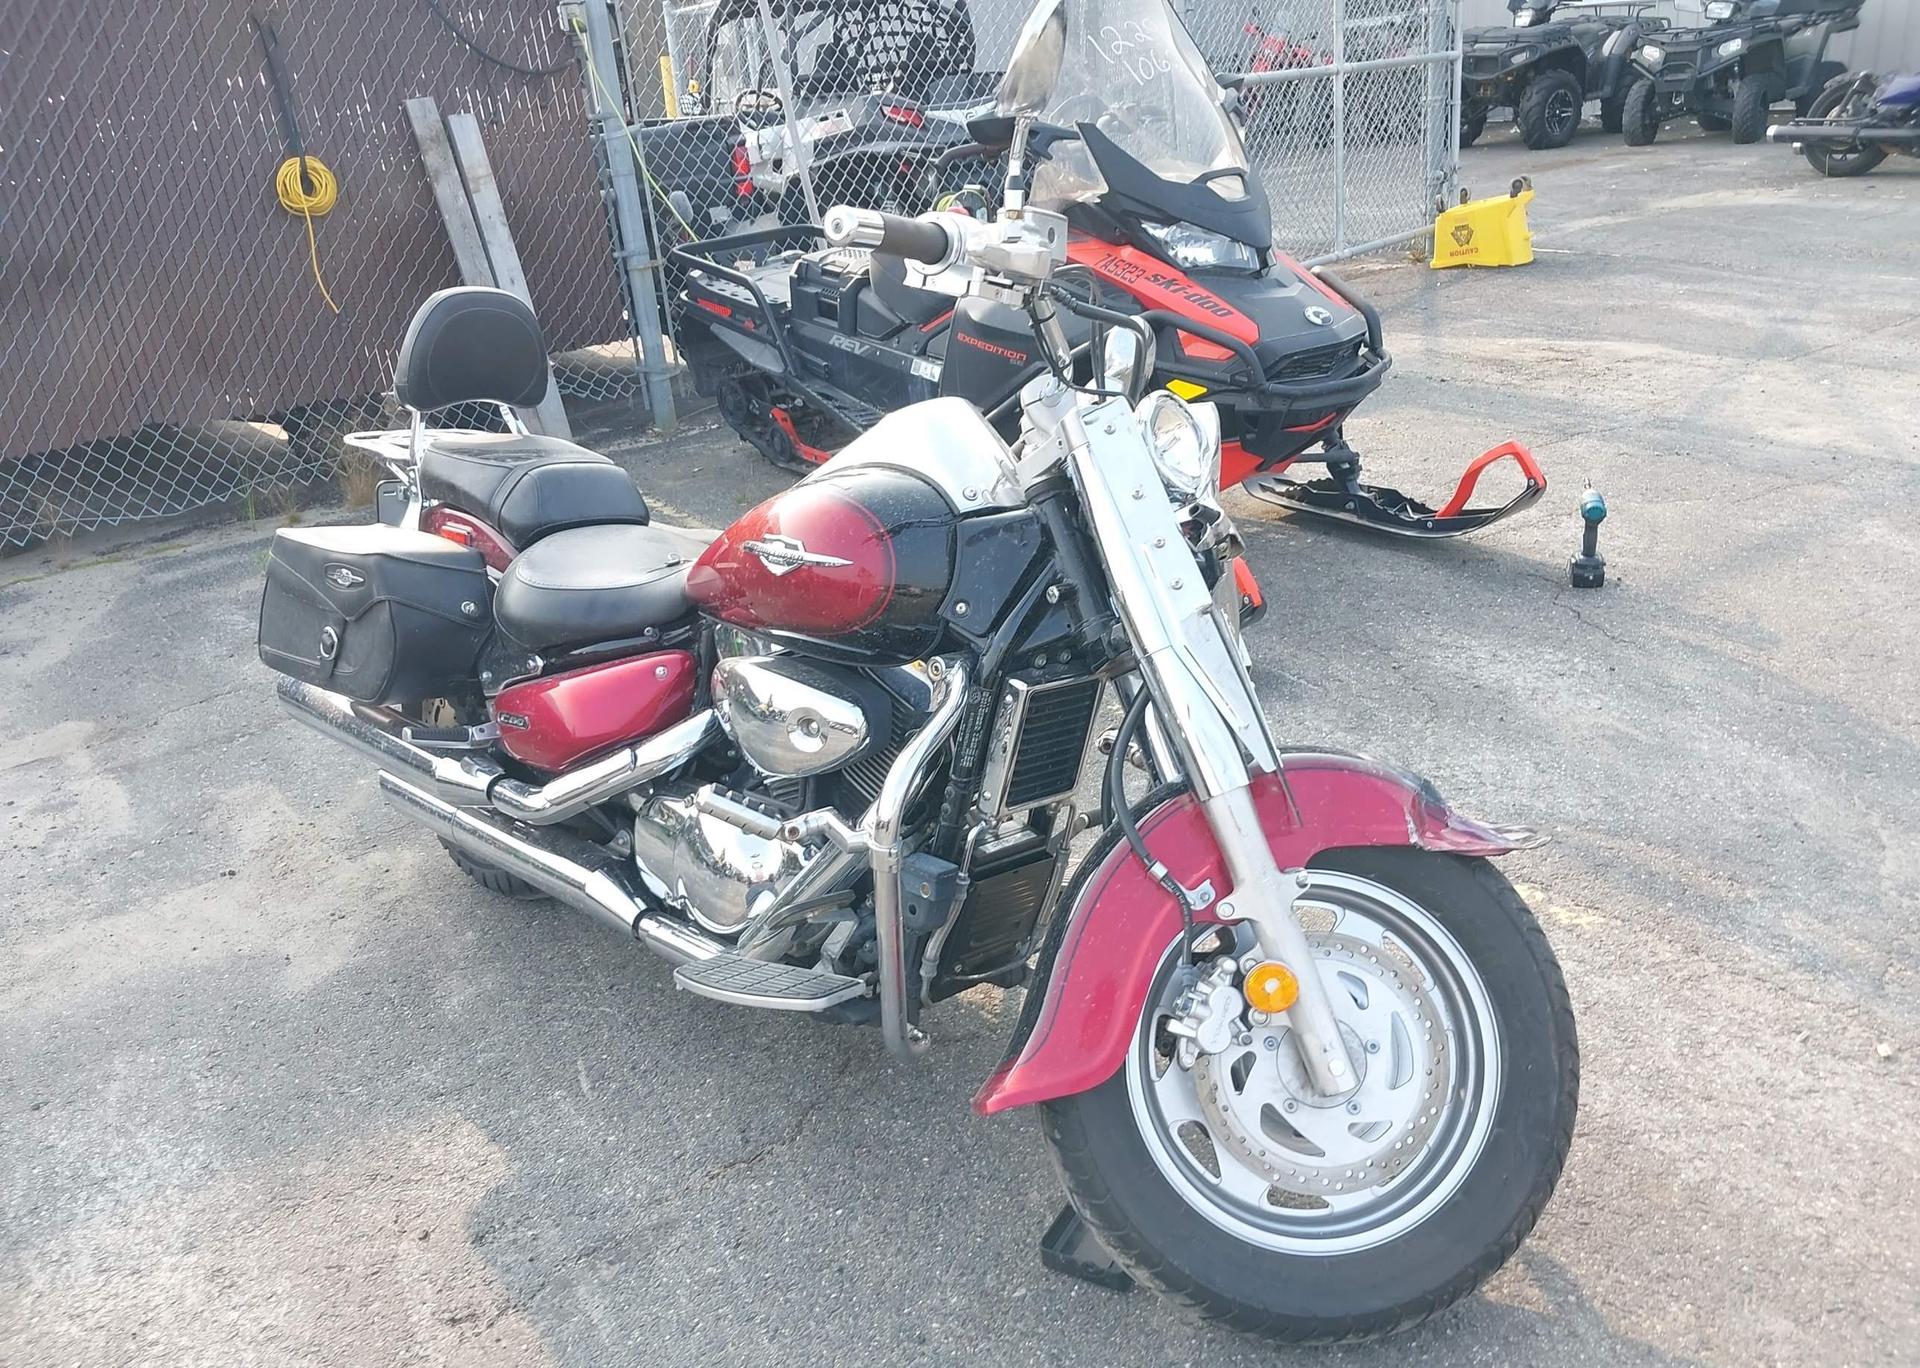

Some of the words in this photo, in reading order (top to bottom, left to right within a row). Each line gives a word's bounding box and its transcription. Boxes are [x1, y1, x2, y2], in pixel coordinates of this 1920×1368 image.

[1450, 247, 1479, 257] CAUTION
[828, 335, 870, 355] REV
[957, 332, 1027, 361] EXPEDITION
